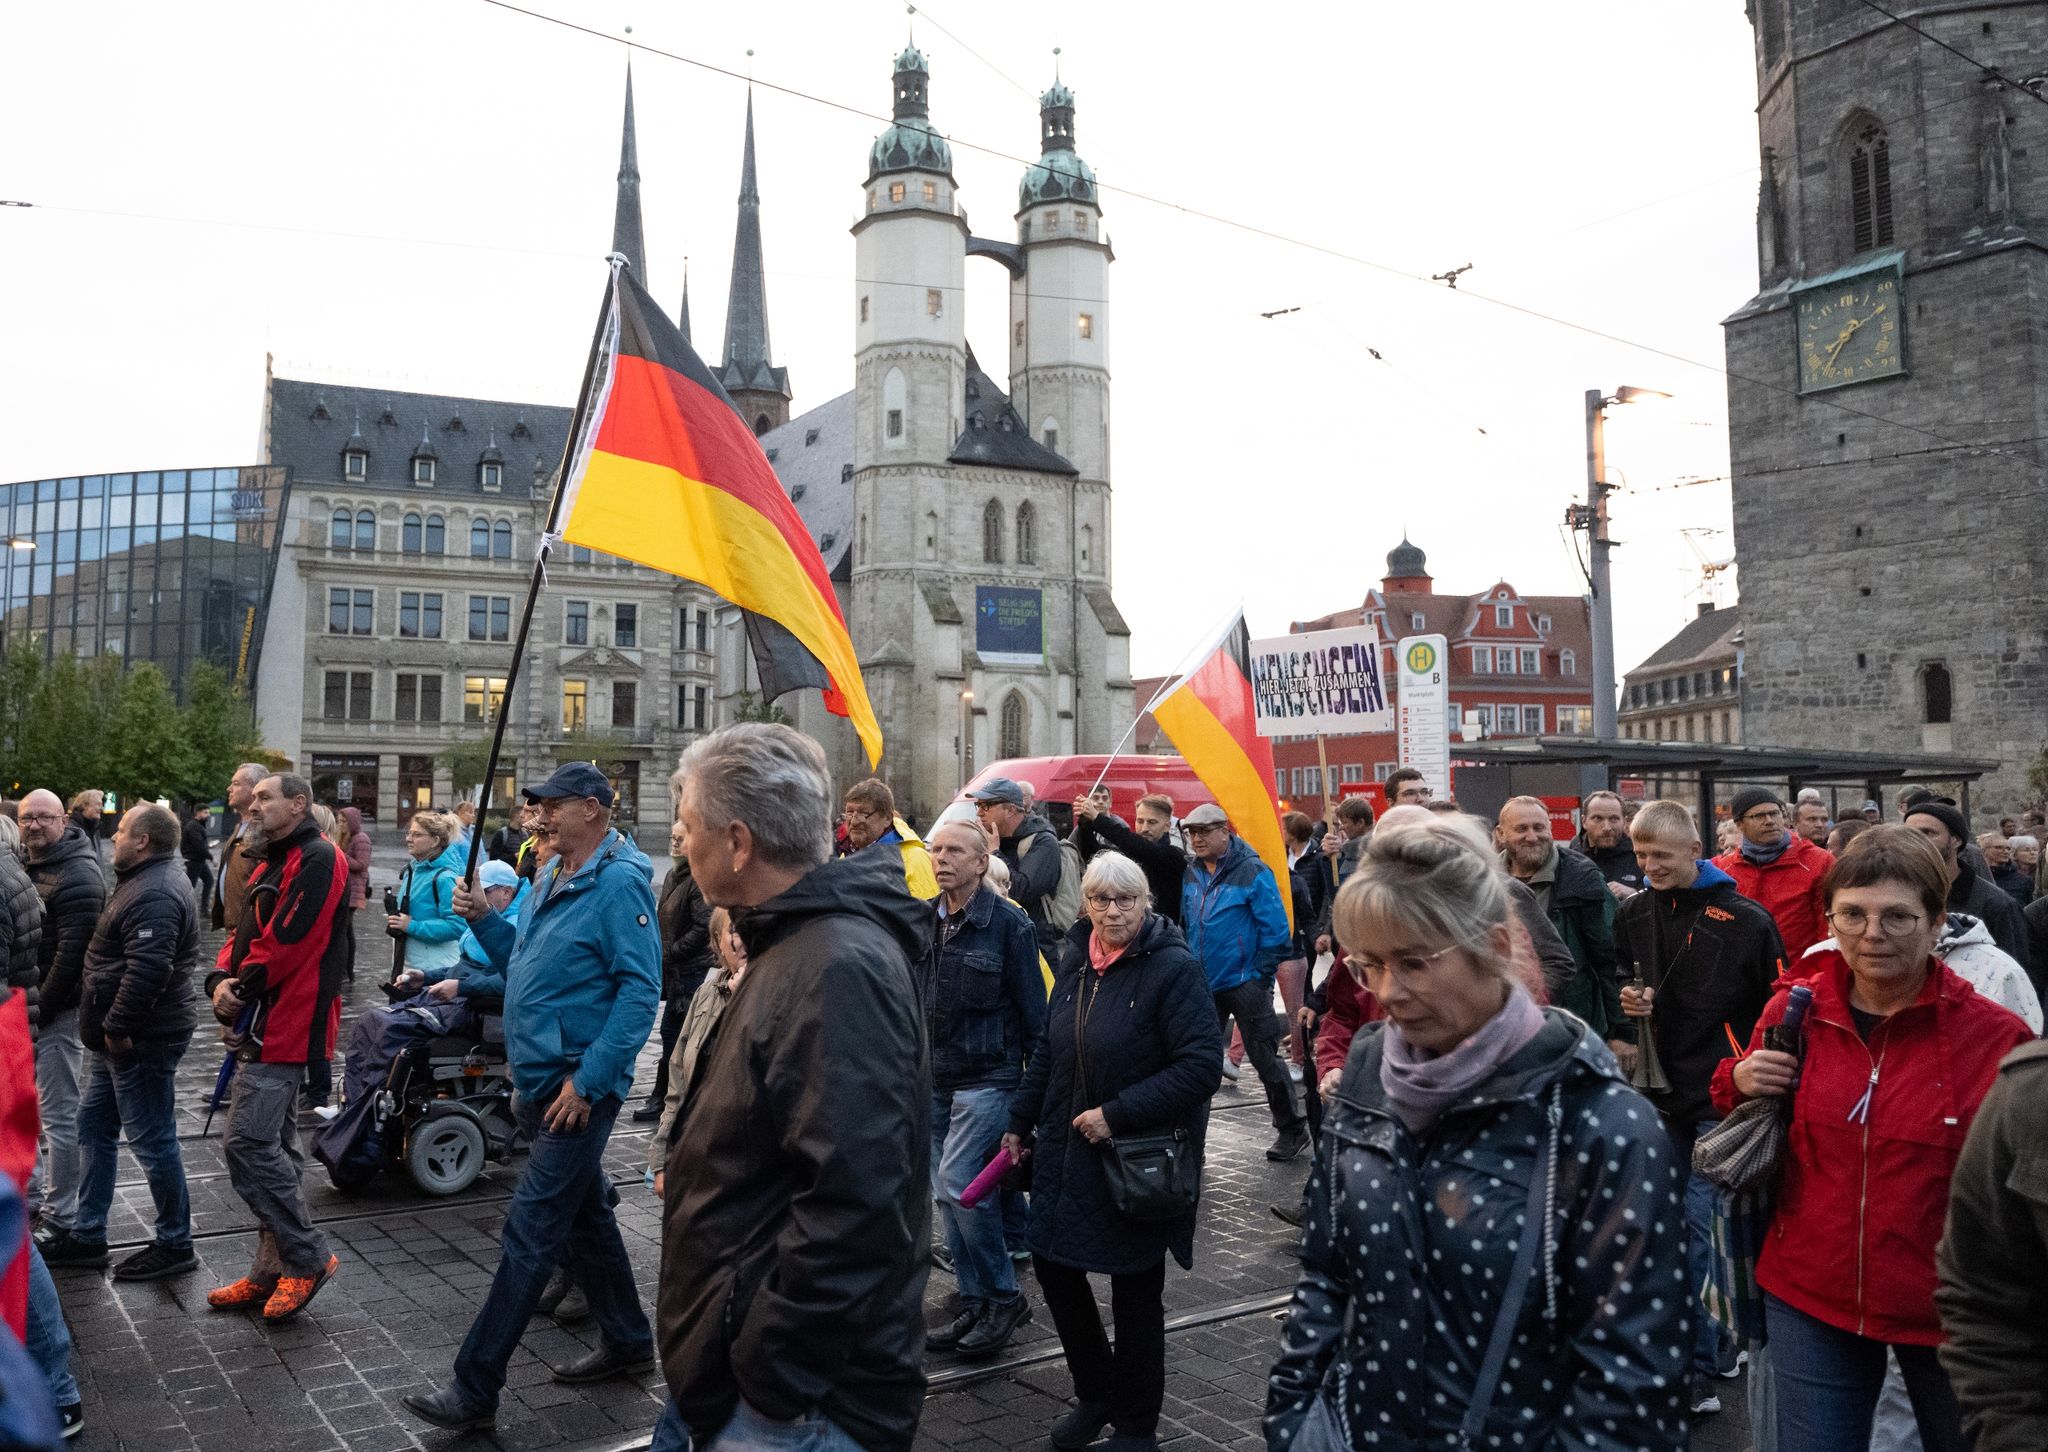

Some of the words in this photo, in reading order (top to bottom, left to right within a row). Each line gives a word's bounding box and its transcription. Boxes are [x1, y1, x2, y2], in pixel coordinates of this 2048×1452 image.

[1415, 648, 1427, 668] H
[1260, 678, 1283, 695] HIER.
[1285, 676, 1312, 694] JETZT.
[1315, 672, 1375, 690] ZUSAMMEN.
[1433, 672, 1440, 684] B
